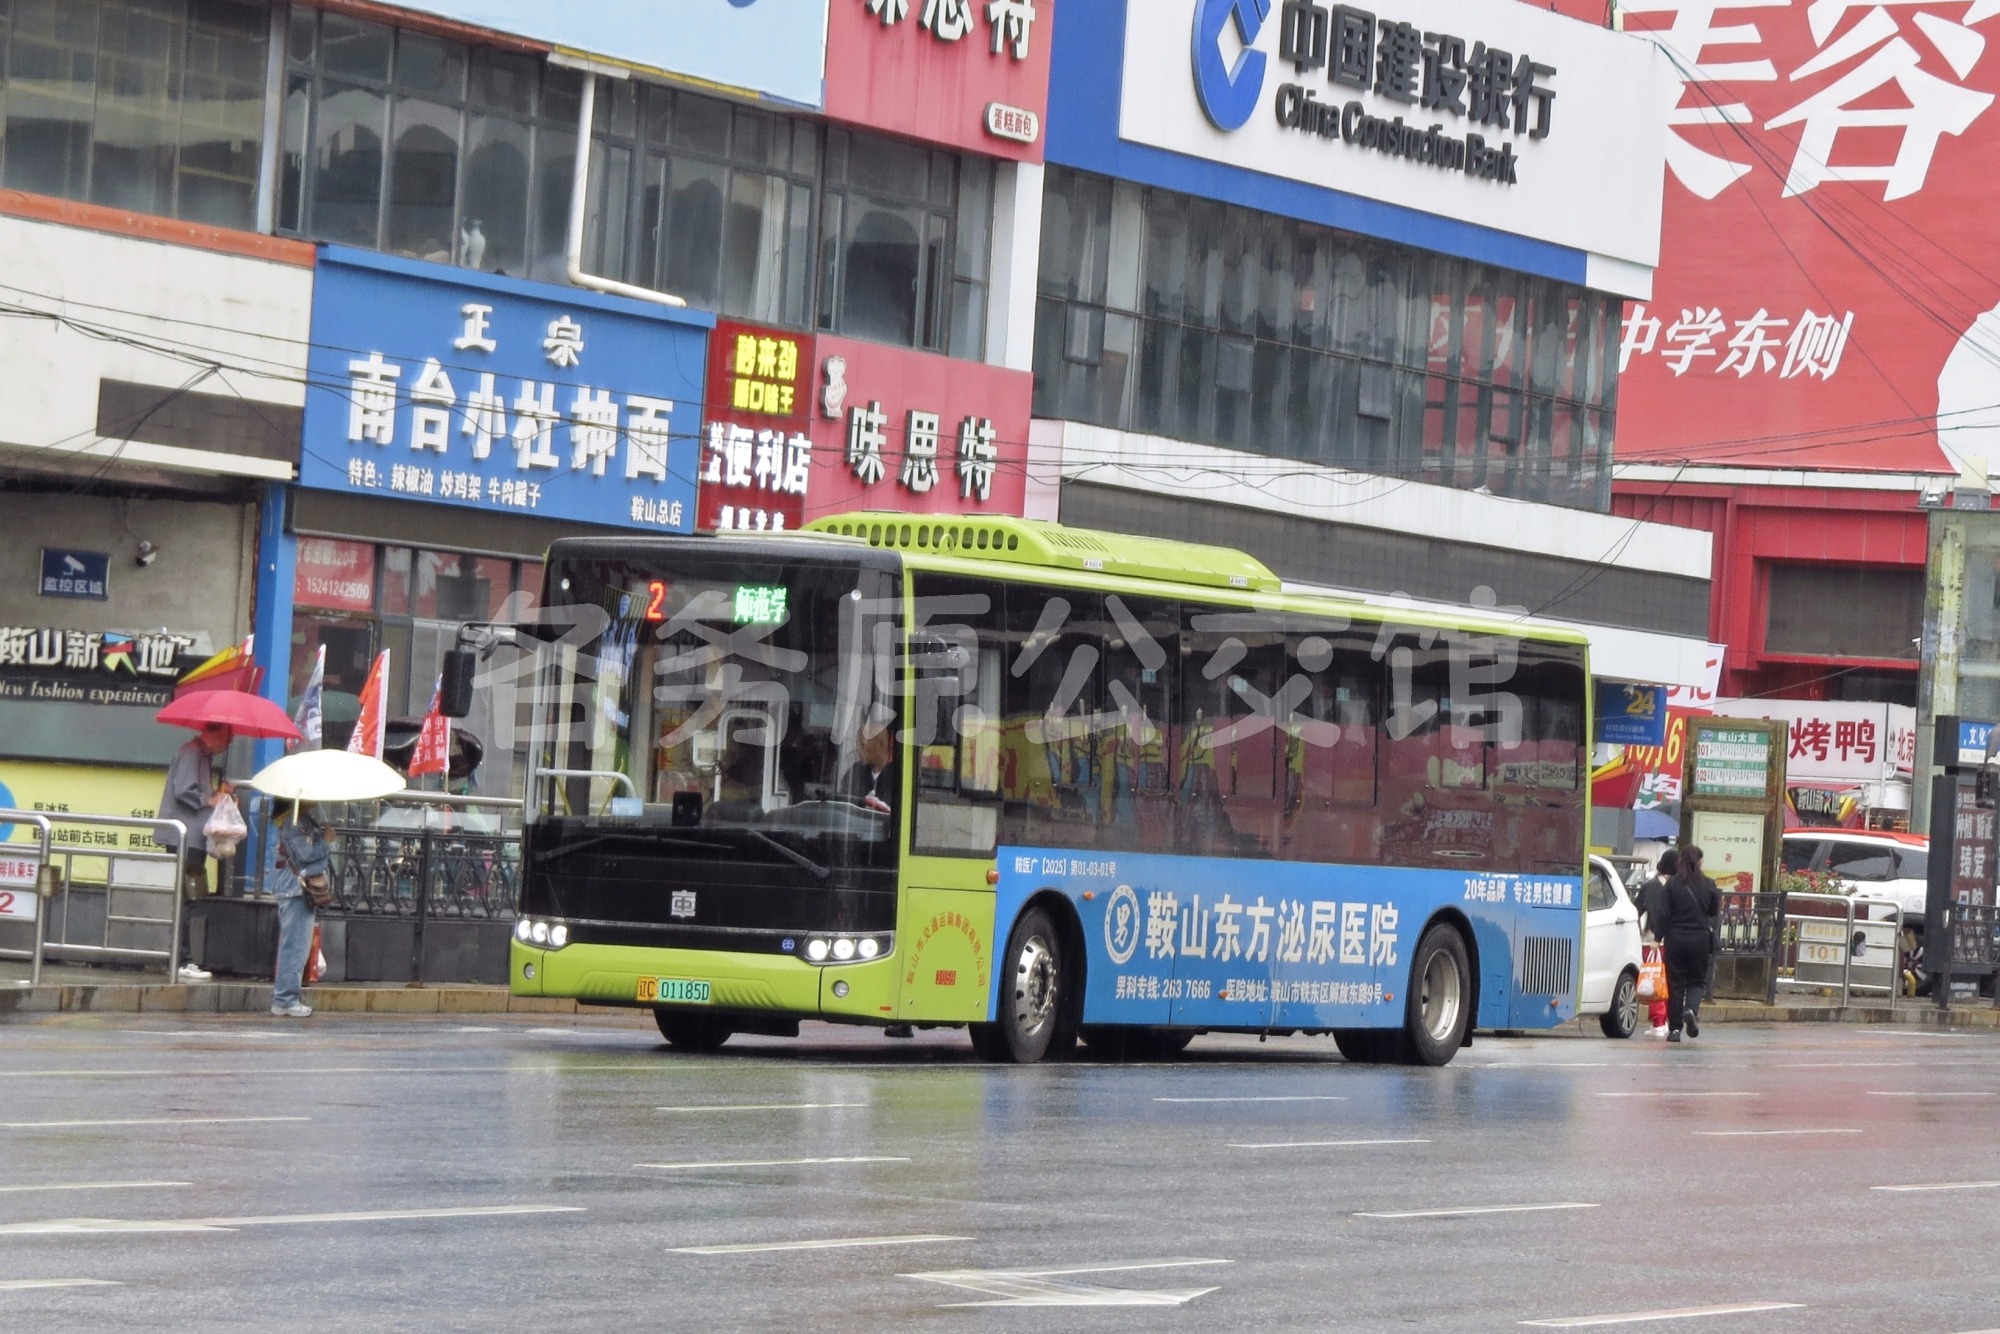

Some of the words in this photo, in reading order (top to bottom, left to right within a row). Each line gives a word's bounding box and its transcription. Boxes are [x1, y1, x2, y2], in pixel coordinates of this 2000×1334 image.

[1280, 0, 1556, 139] 中国建设银行
[994, 107, 1032, 137] 蛋糕面包
[1275, 83, 1340, 139] China
[1342, 101, 1465, 170] Construction
[1464, 133, 1518, 184] Bank
[724, 424, 812, 494] 便利店
[847, 400, 998, 500] 味思特
[391, 464, 433, 495] 辣椒油
[440, 470, 481, 501] 炒鸡架
[631, 496, 682, 526] 鞍山总店
[44, 577, 103, 594] 监控区域
[307, 577, 370, 600] 15241242500
[648, 582, 665, 619] 2
[1626, 689, 1656, 714] 24
[1718, 732, 1758, 743] 鞍山大厦
[1789, 717, 1876, 763] 烤鸭
[1464, 879, 1506, 902] 20年品牌
[1514, 882, 1573, 905] 专注男性健康
[1145, 891, 1399, 966] 鞍山东方泌尿医院
[1808, 945, 1839, 961] 101
[639, 980, 656, 997] 辽C
[661, 981, 709, 1000] 01185D
[1162, 978, 1182, 999] 263
[1185, 979, 1211, 999] 7666
